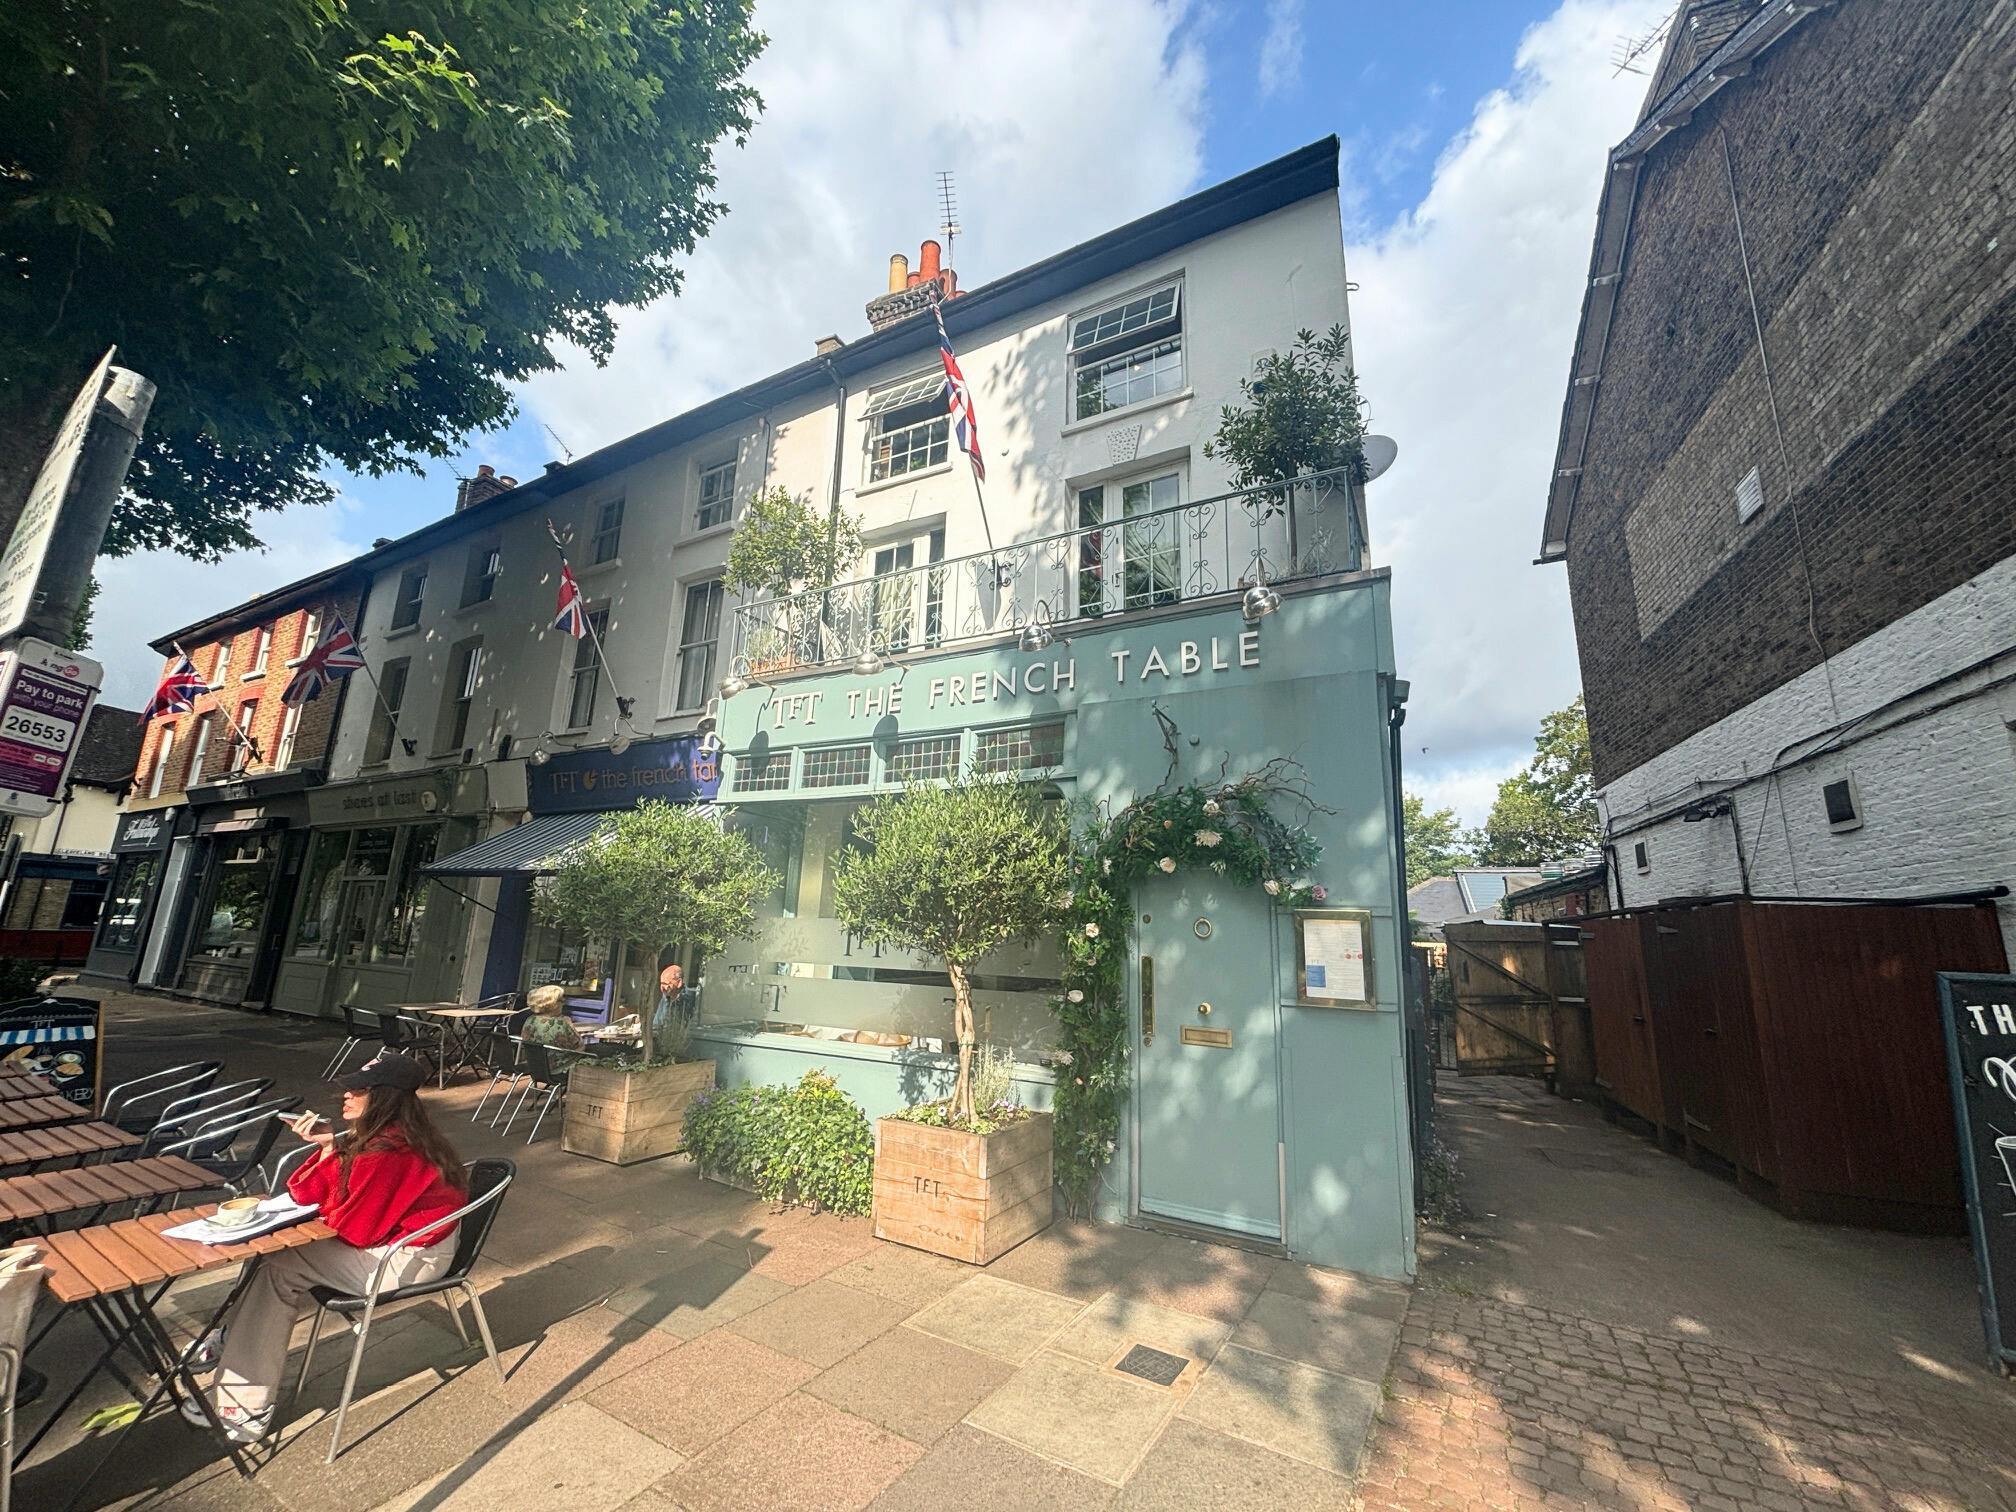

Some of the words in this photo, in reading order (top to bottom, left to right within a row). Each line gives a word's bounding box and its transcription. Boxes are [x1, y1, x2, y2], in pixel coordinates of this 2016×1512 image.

[770, 691, 823, 729] TFT
[847, 685, 903, 719] THE
[928, 658, 1075, 710] FRENCH
[1111, 631, 1260, 683] TABLE
[17, 680, 40, 697] Pay
[42, 688, 55, 700] to
[55, 694, 84, 709] park
[33, 700, 53, 709] your
[53, 705, 80, 718] phone
[5, 716, 66, 743] 26553
[549, 770, 578, 794] TFT
[601, 769, 627, 789] the
[632, 763, 688, 788] french
[587, 1104, 603, 1119] TFT
[913, 1176, 942, 1199] TFT
